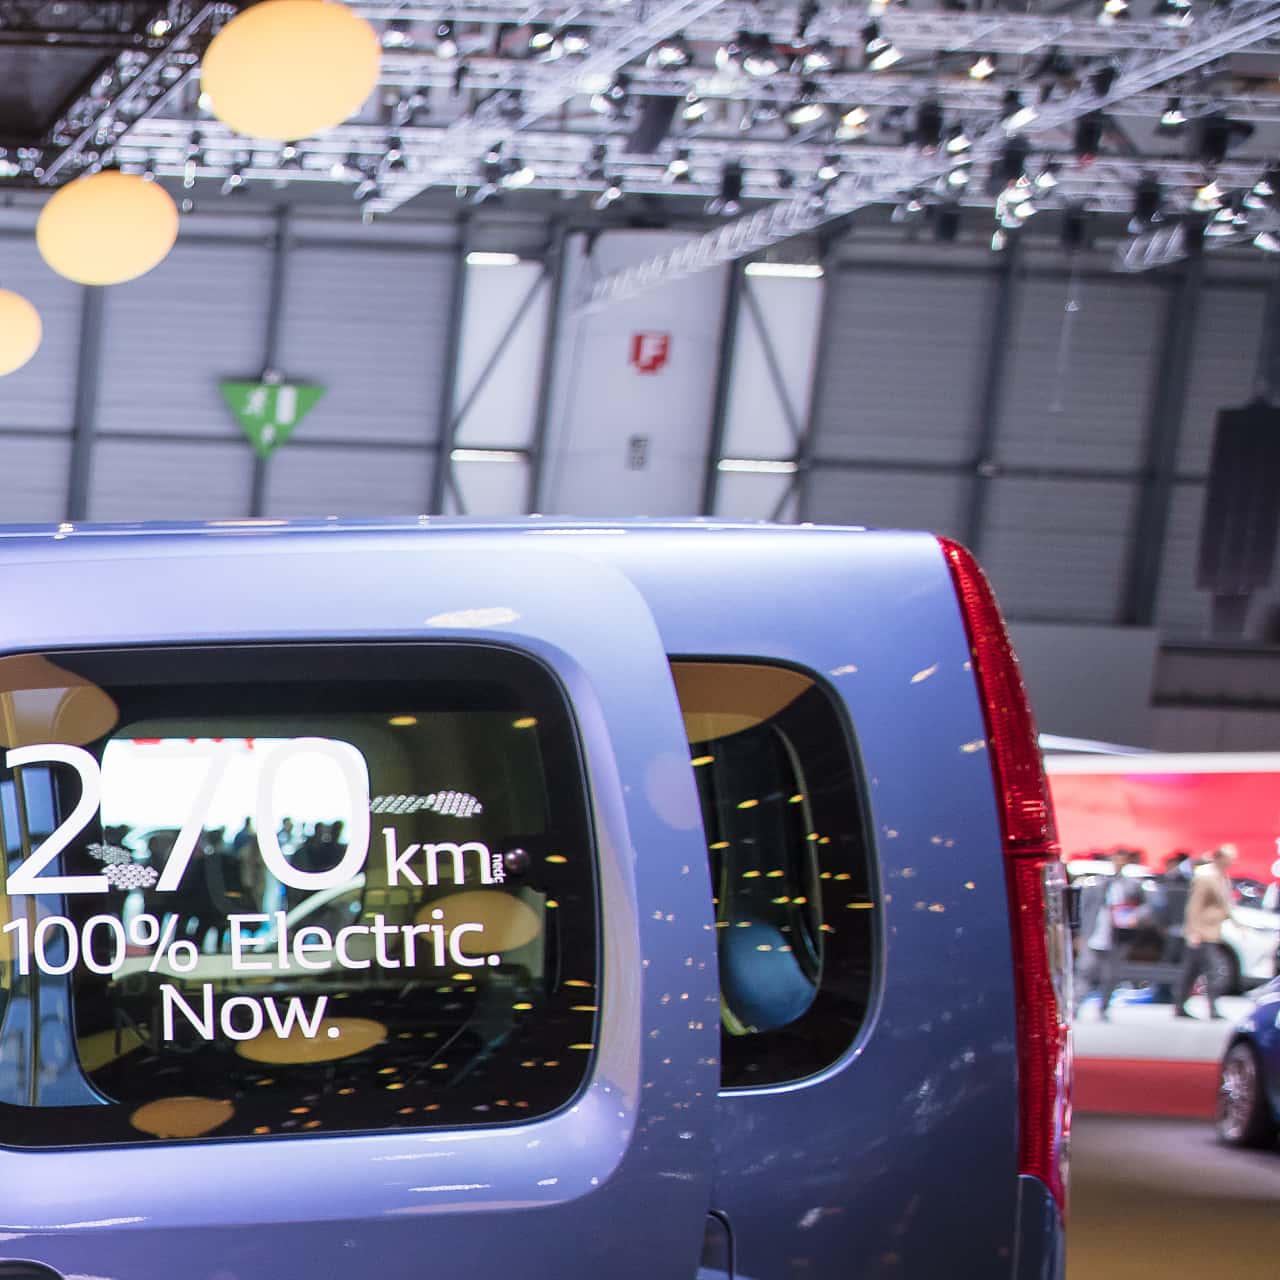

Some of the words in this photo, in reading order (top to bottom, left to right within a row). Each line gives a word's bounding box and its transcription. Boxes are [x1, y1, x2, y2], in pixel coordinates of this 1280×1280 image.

[3, 736, 371, 895] 270
[381, 827, 494, 886] km
[1, 912, 200, 977] 100%
[226, 908, 501, 971] Electric.
[159, 982, 342, 1042] Now.
